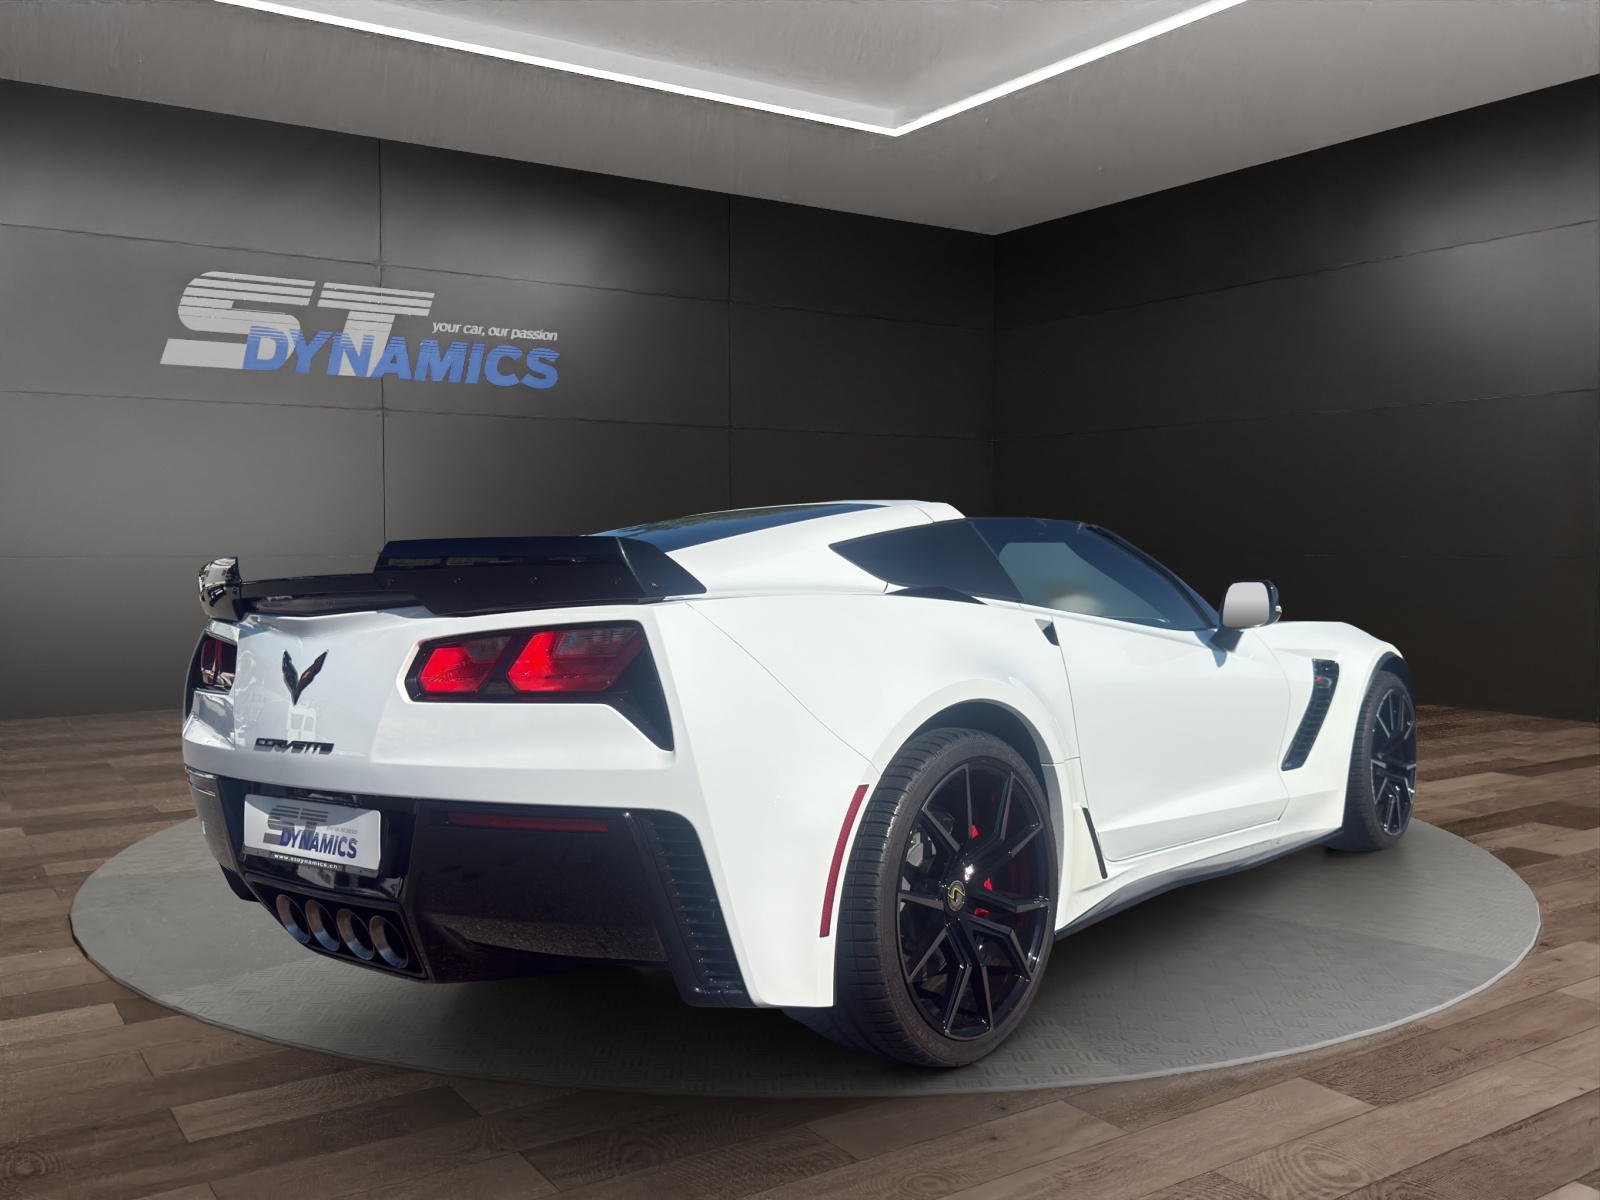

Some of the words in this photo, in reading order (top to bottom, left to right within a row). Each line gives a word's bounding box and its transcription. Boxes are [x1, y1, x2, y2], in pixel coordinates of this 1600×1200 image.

[160, 271, 436, 377] ST
[432, 322, 462, 333] your
[463, 324, 486, 336] car,
[488, 326, 510, 337] our
[511, 329, 558, 341] passion
[242, 325, 561, 389] DYNAMICS
[254, 737, 335, 753] CORVETTE
[279, 827, 358, 859] DYNAMICS
